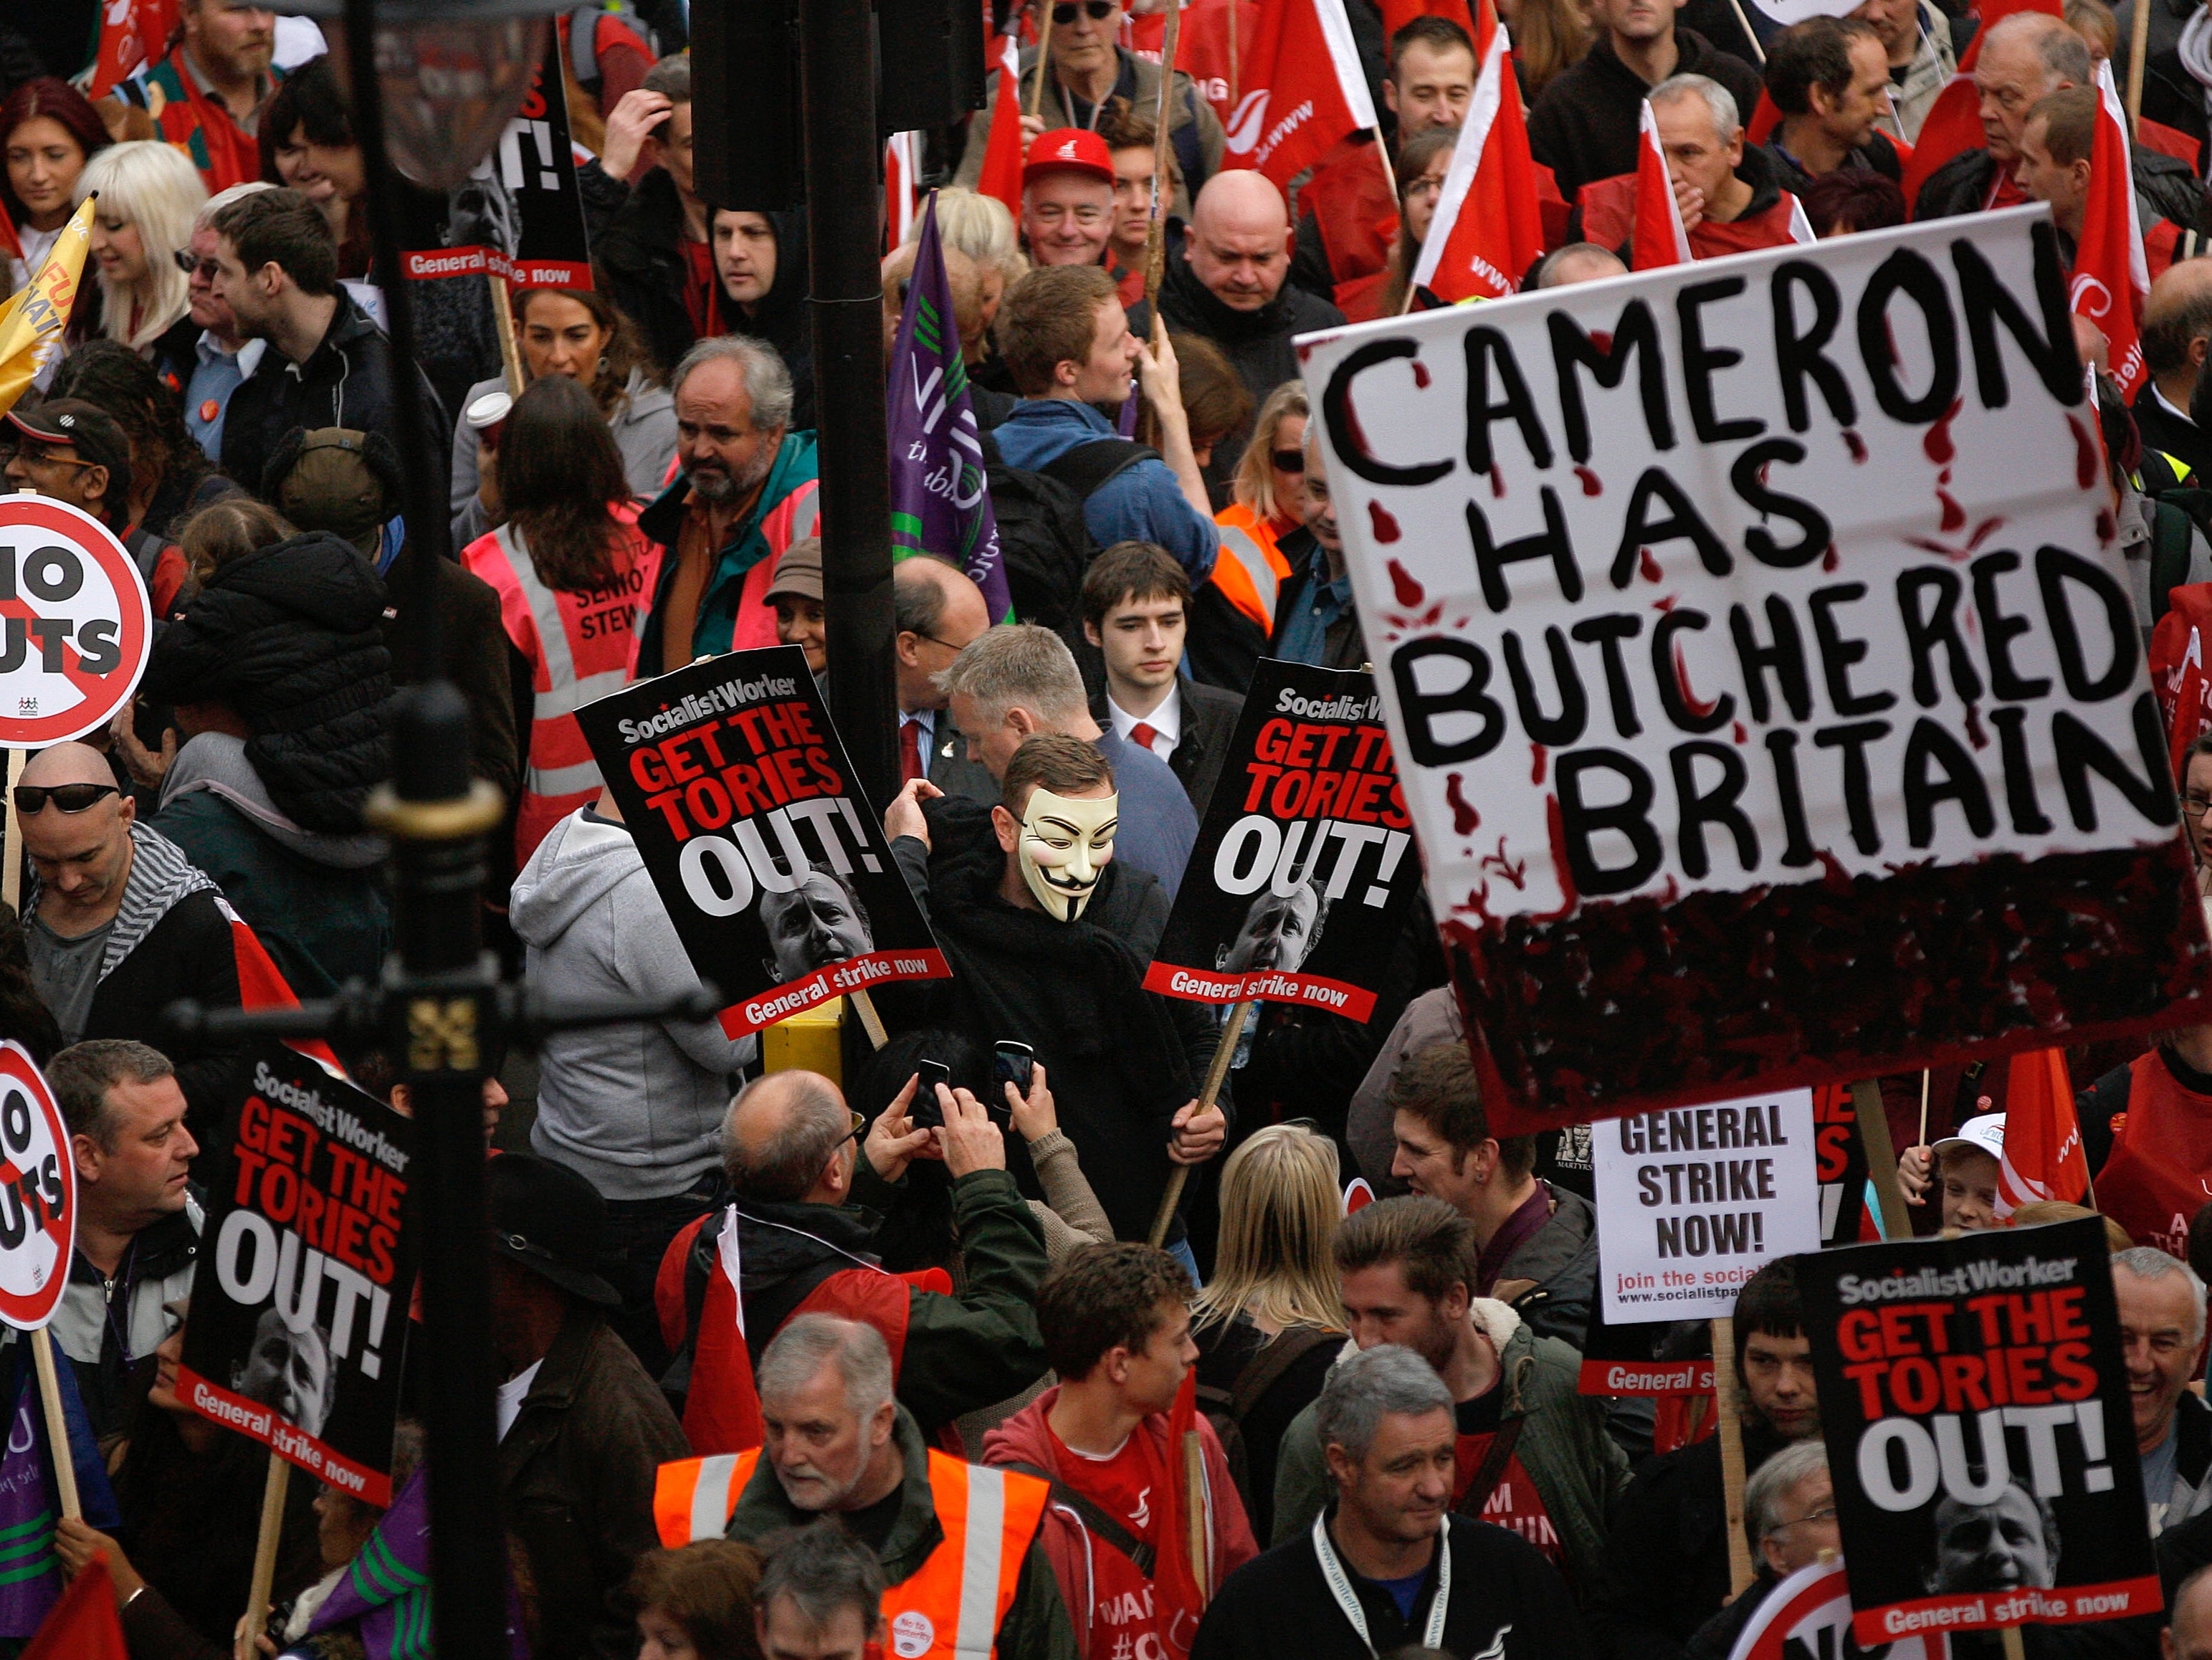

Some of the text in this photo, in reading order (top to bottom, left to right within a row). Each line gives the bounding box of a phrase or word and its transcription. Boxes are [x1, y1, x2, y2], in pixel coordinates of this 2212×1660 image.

[410, 251, 571, 284] General strike now
[1322, 221, 2087, 486] CAMERON
[1467, 438, 1834, 612] HAS
[575, 567, 648, 608] SENIO
[581, 604, 637, 639] STEW
[1391, 545, 2140, 768] BUTCHERED
[629, 702, 824, 793] GET THE
[1255, 718, 1350, 768] GET
[645, 746, 843, 842] TORIES
[1244, 763, 1412, 829] TORIES
[1557, 691, 2181, 895] BRITAIN
[679, 798, 884, 917] OUT!
[1214, 814, 1411, 909] OUT!
[745, 958, 928, 1025] General strike now
[1171, 971, 1348, 1008] General strike now
[239, 1095, 408, 1231] GET THE
[1621, 1105, 1789, 1155] GENERAL
[234, 1143, 398, 1285] TORIES
[1638, 1158, 1778, 1207] STRIKE
[1656, 1212, 1765, 1259] NOW!
[216, 1209, 391, 1380] OUT!
[1617, 1265, 1763, 1294] join the socia
[1618, 1287, 1744, 1304] www.socialistpa
[1836, 1286, 2092, 1362] GET THE
[1608, 1367, 1694, 1391] General
[1841, 1342, 2099, 1420] TORIES
[194, 1383, 366, 1492] General strike now
[1857, 1399, 2115, 1512] OUT!
[1885, 1590, 2130, 1635] General strike now
